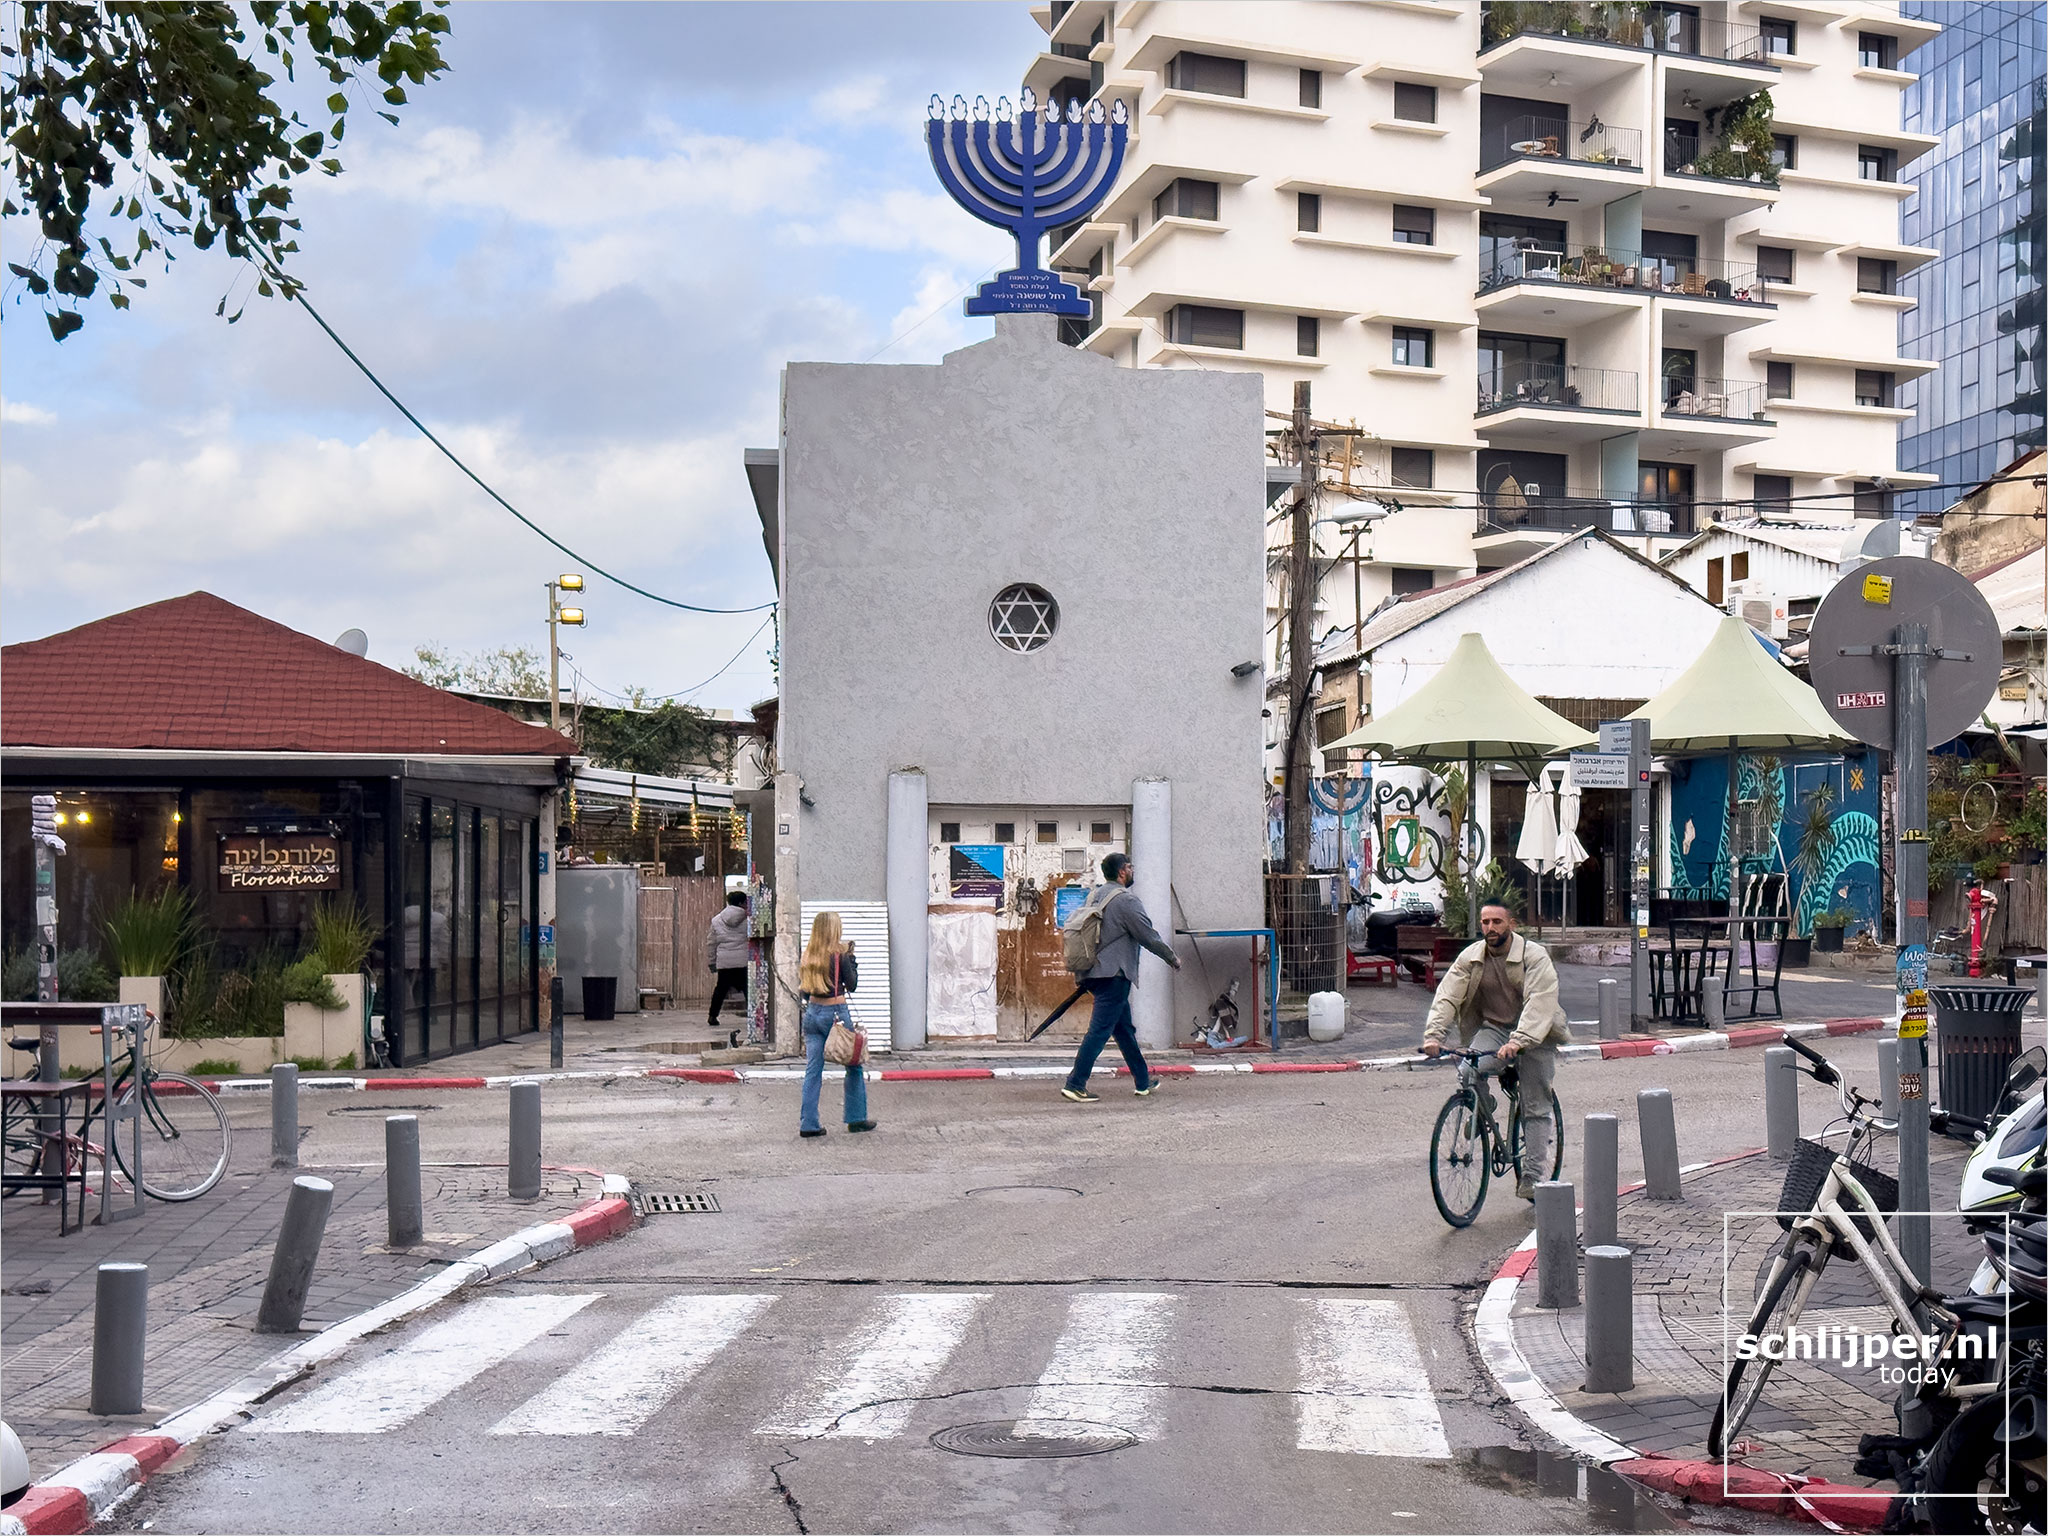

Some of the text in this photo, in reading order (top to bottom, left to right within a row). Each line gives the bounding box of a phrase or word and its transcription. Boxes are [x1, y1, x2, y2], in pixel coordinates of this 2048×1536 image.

[1016, 292, 1046, 300] שושנה
[1048, 291, 1066, 300] רחל
[224, 838, 336, 865] פלורנטינה
[231, 871, 329, 887] Florentina
